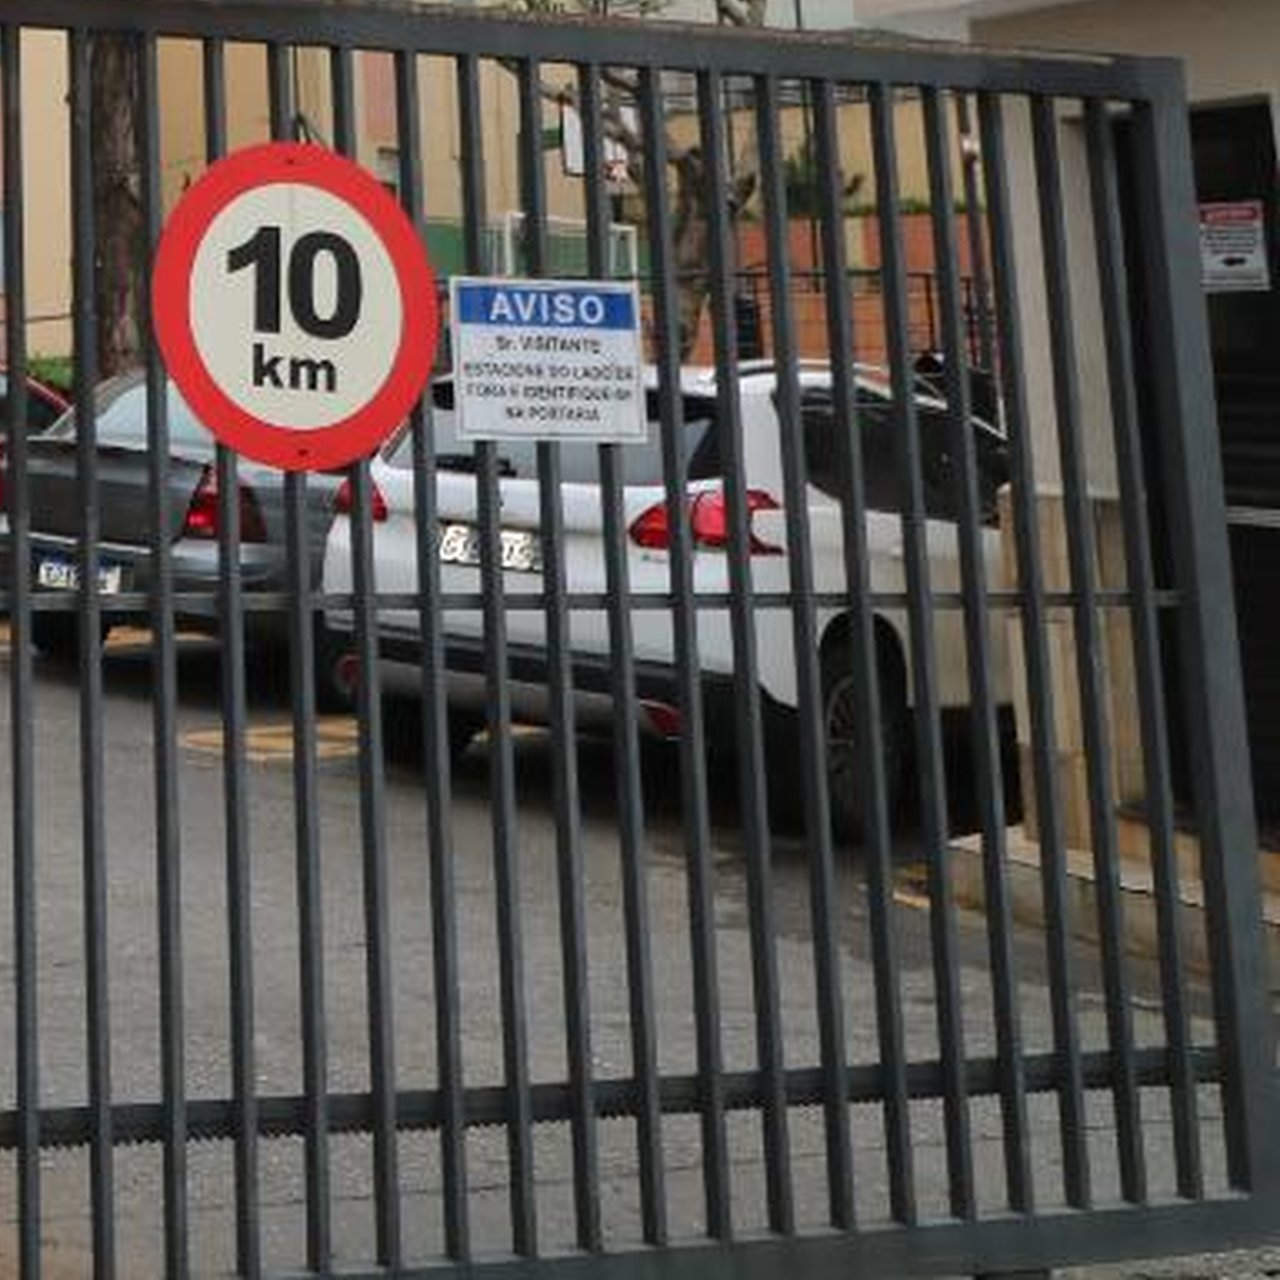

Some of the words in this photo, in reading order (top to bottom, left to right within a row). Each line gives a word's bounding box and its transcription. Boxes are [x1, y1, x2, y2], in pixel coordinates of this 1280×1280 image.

[227, 226, 362, 340] 10
[490, 293, 604, 324] AVISO
[520, 335, 601, 354] VISITANTE
[252, 344, 337, 391] km
[528, 406, 601, 421] PORTARIA
